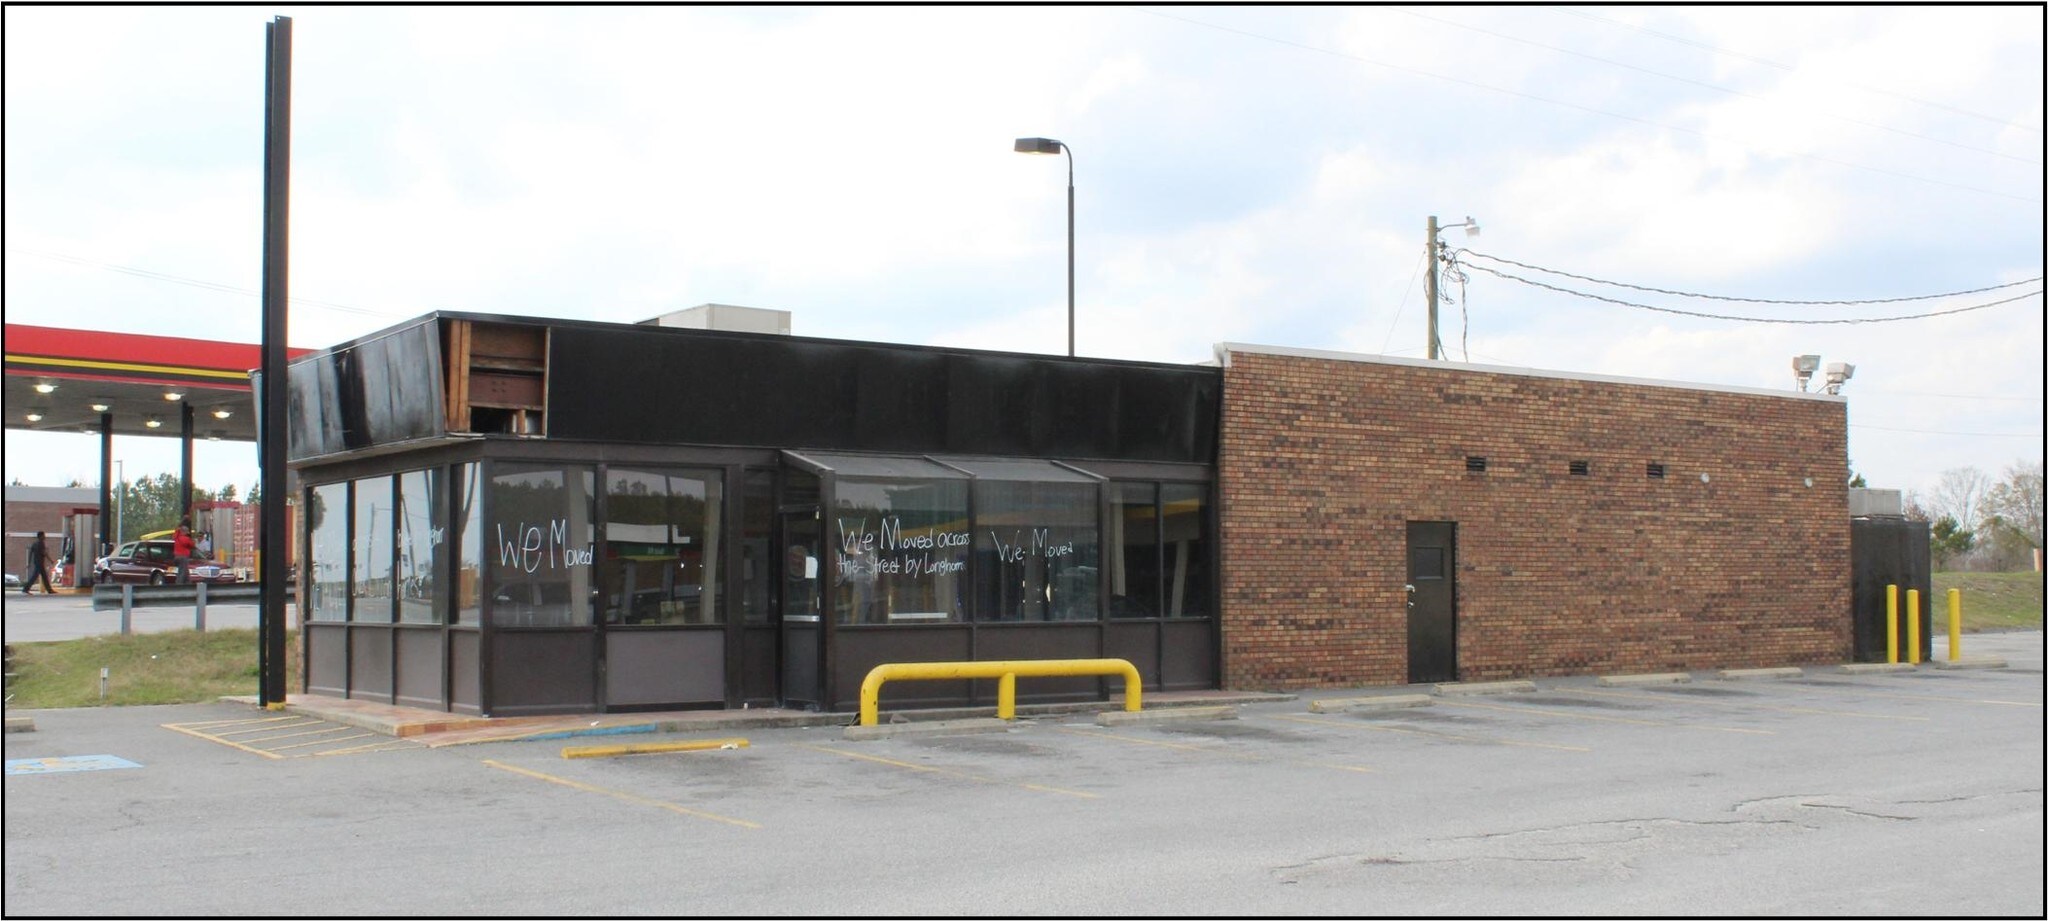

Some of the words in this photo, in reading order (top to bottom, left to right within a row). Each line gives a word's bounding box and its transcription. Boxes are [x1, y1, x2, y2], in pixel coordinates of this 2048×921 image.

[497, 522, 542, 573] We
[551, 519, 594, 568] Moved
[838, 518, 874, 552] We
[880, 517, 934, 551] Moved
[937, 531, 970, 547] across
[1032, 528, 1073, 558] Moved
[905, 554, 922, 579] by
